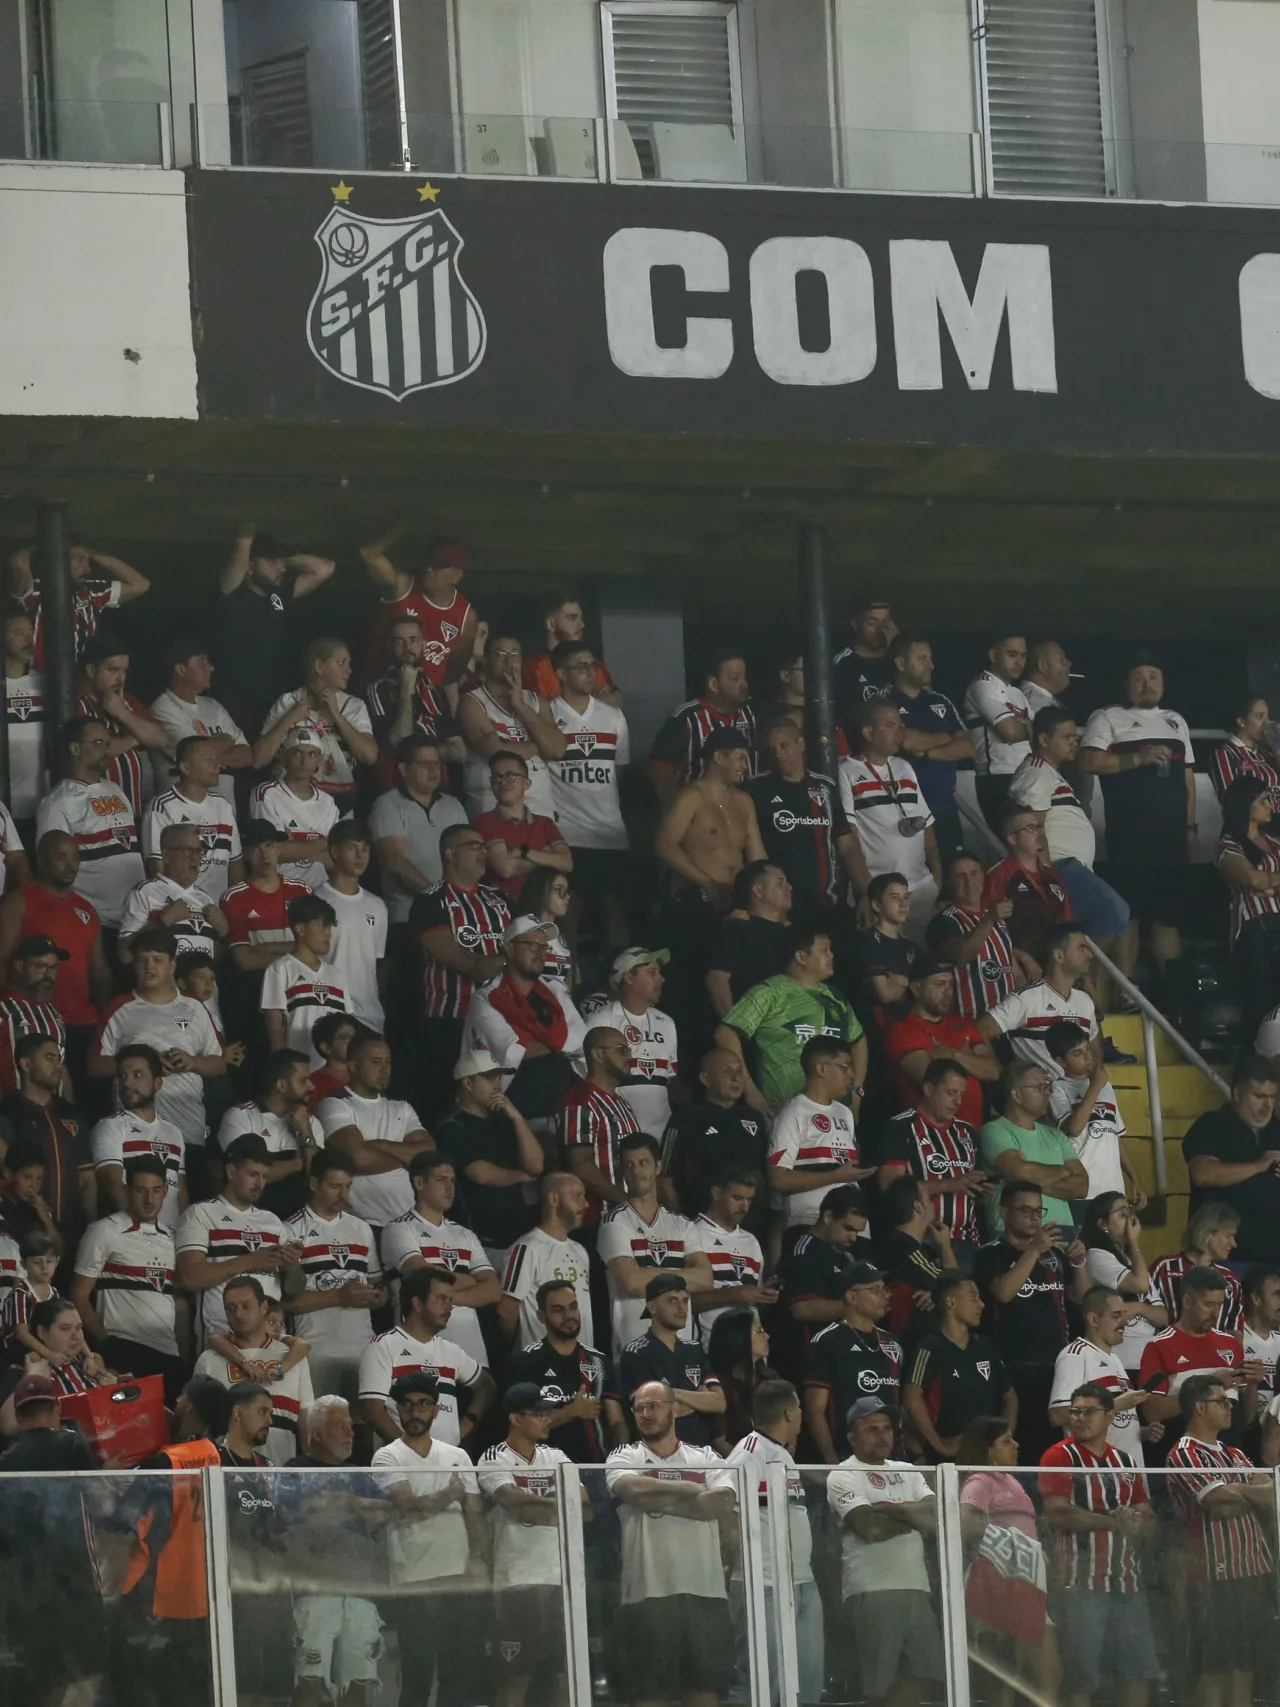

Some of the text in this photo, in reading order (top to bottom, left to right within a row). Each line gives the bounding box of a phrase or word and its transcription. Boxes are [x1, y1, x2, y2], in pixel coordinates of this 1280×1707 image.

[603, 227, 1058, 393] COM
[561, 762, 610, 783] inter
[90, 796, 127, 816] BMG
[779, 815, 830, 828] Sportsbet.io
[645, 1031, 665, 1044] LG
[834, 1119, 848, 1132] LG
